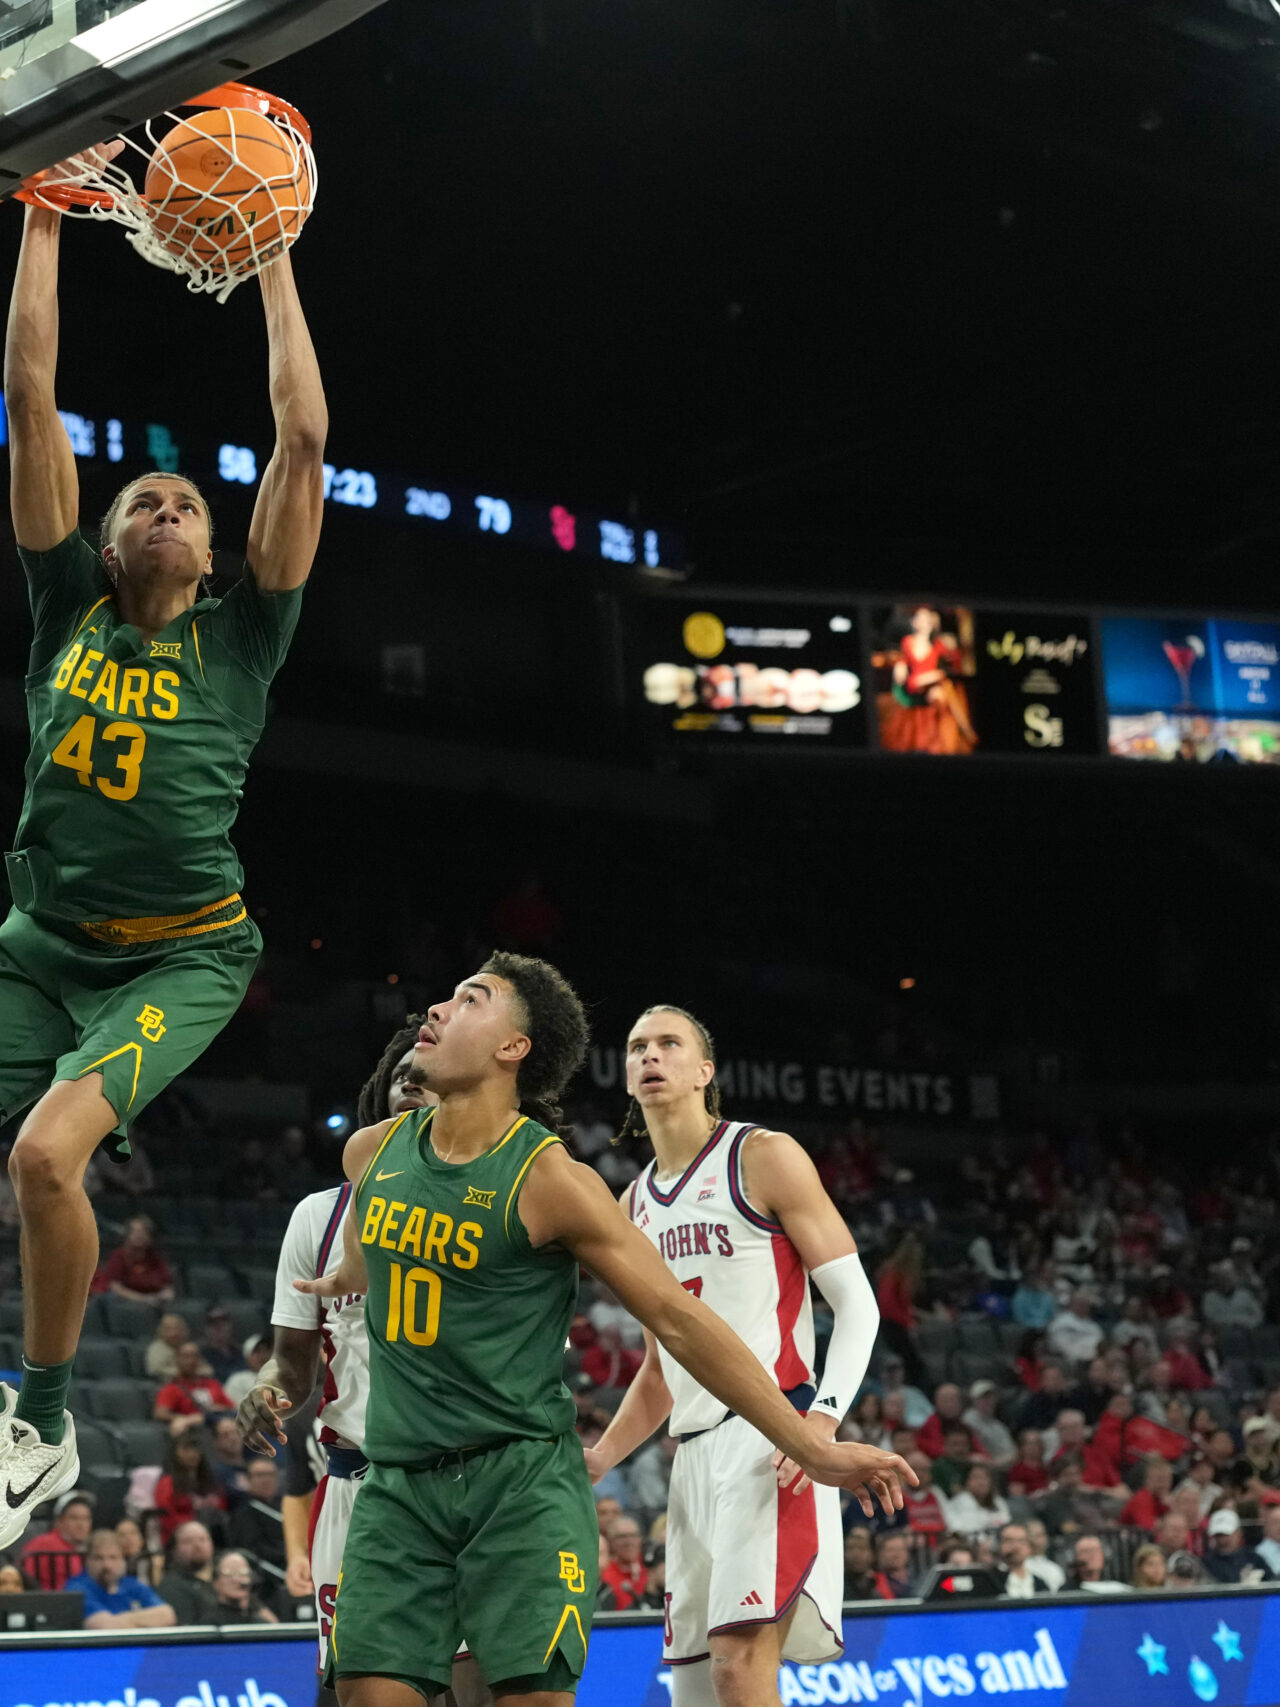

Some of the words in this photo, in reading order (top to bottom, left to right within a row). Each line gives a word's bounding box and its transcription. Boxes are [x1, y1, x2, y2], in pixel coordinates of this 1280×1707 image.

[54, 643, 180, 720] BEARS
[52, 714, 146, 801] 43
[136, 1004, 167, 1043] BU
[816, 1065, 954, 1116] EVENTS
[361, 1196, 483, 1270] BEARS
[386, 1263, 442, 1346] 10
[558, 1551, 586, 1593] BU
[892, 1651, 976, 1707] yes
[976, 1628, 1068, 1695] and
